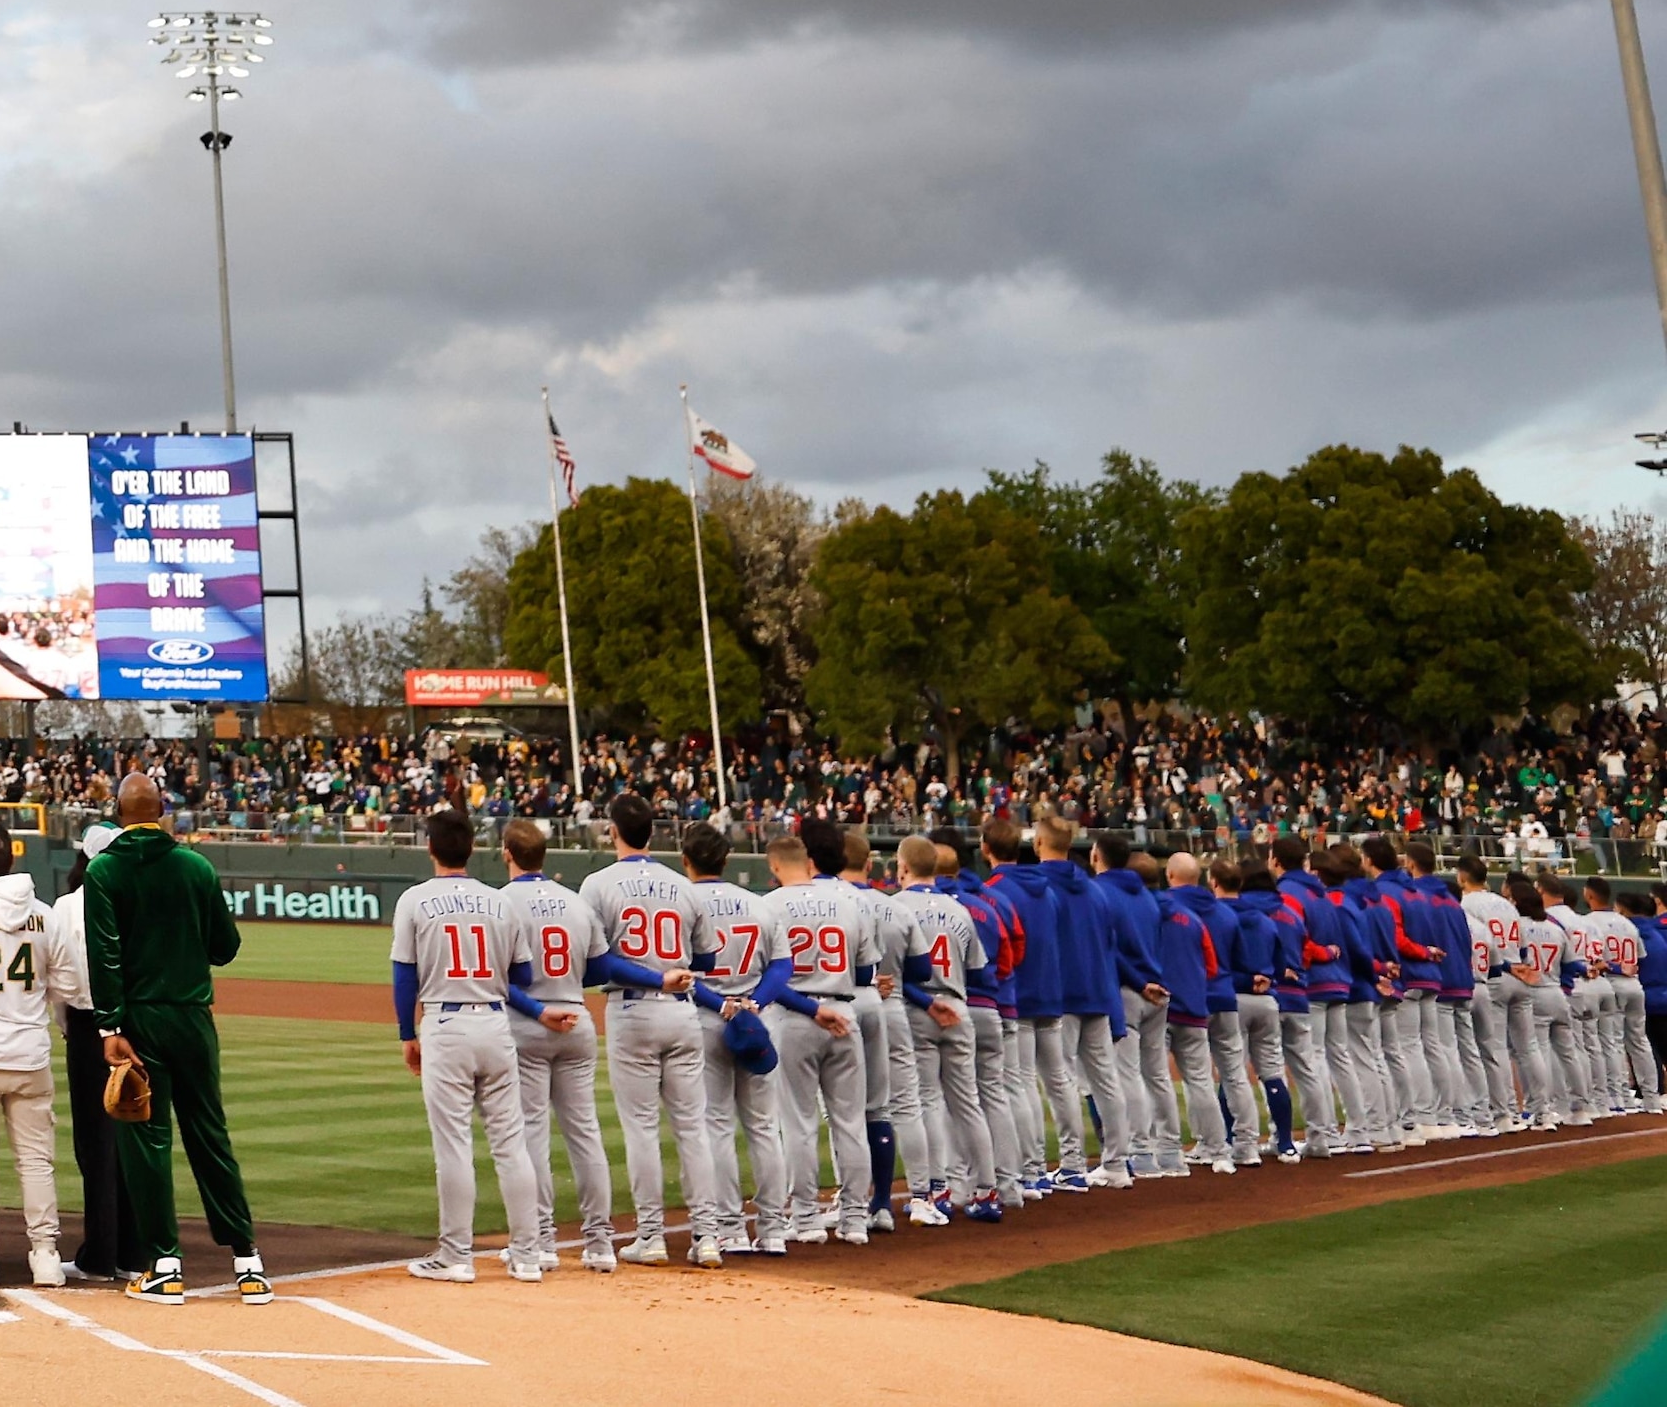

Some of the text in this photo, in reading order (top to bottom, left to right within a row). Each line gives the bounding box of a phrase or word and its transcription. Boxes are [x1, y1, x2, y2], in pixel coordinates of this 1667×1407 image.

[111, 470, 231, 495] O'ER THE LAND
[123, 504, 222, 529] OF THE FREE
[114, 539, 235, 563] AND THE HOME
[148, 573, 205, 598] OF THE
[150, 607, 205, 632] BRAVE
[159, 641, 201, 660] Ford
[142, 668, 185, 679] California
[185, 668, 207, 679] Ford
[466, 676, 500, 690] RUN
[502, 676, 537, 690] HILL
[255, 883, 379, 920] Health
[615, 880, 678, 901] TUCKER
[420, 895, 504, 920] COUNSELL
[530, 898, 567, 918] HAPP
[785, 900, 837, 918] BUSCH
[620, 906, 683, 960] 30
[1488, 919, 1520, 949] 94
[444, 923, 494, 979] 11
[541, 925, 571, 978] 8
[787, 925, 846, 973] 29
[929, 933, 952, 978] 4
[1606, 935, 1637, 965] 90
